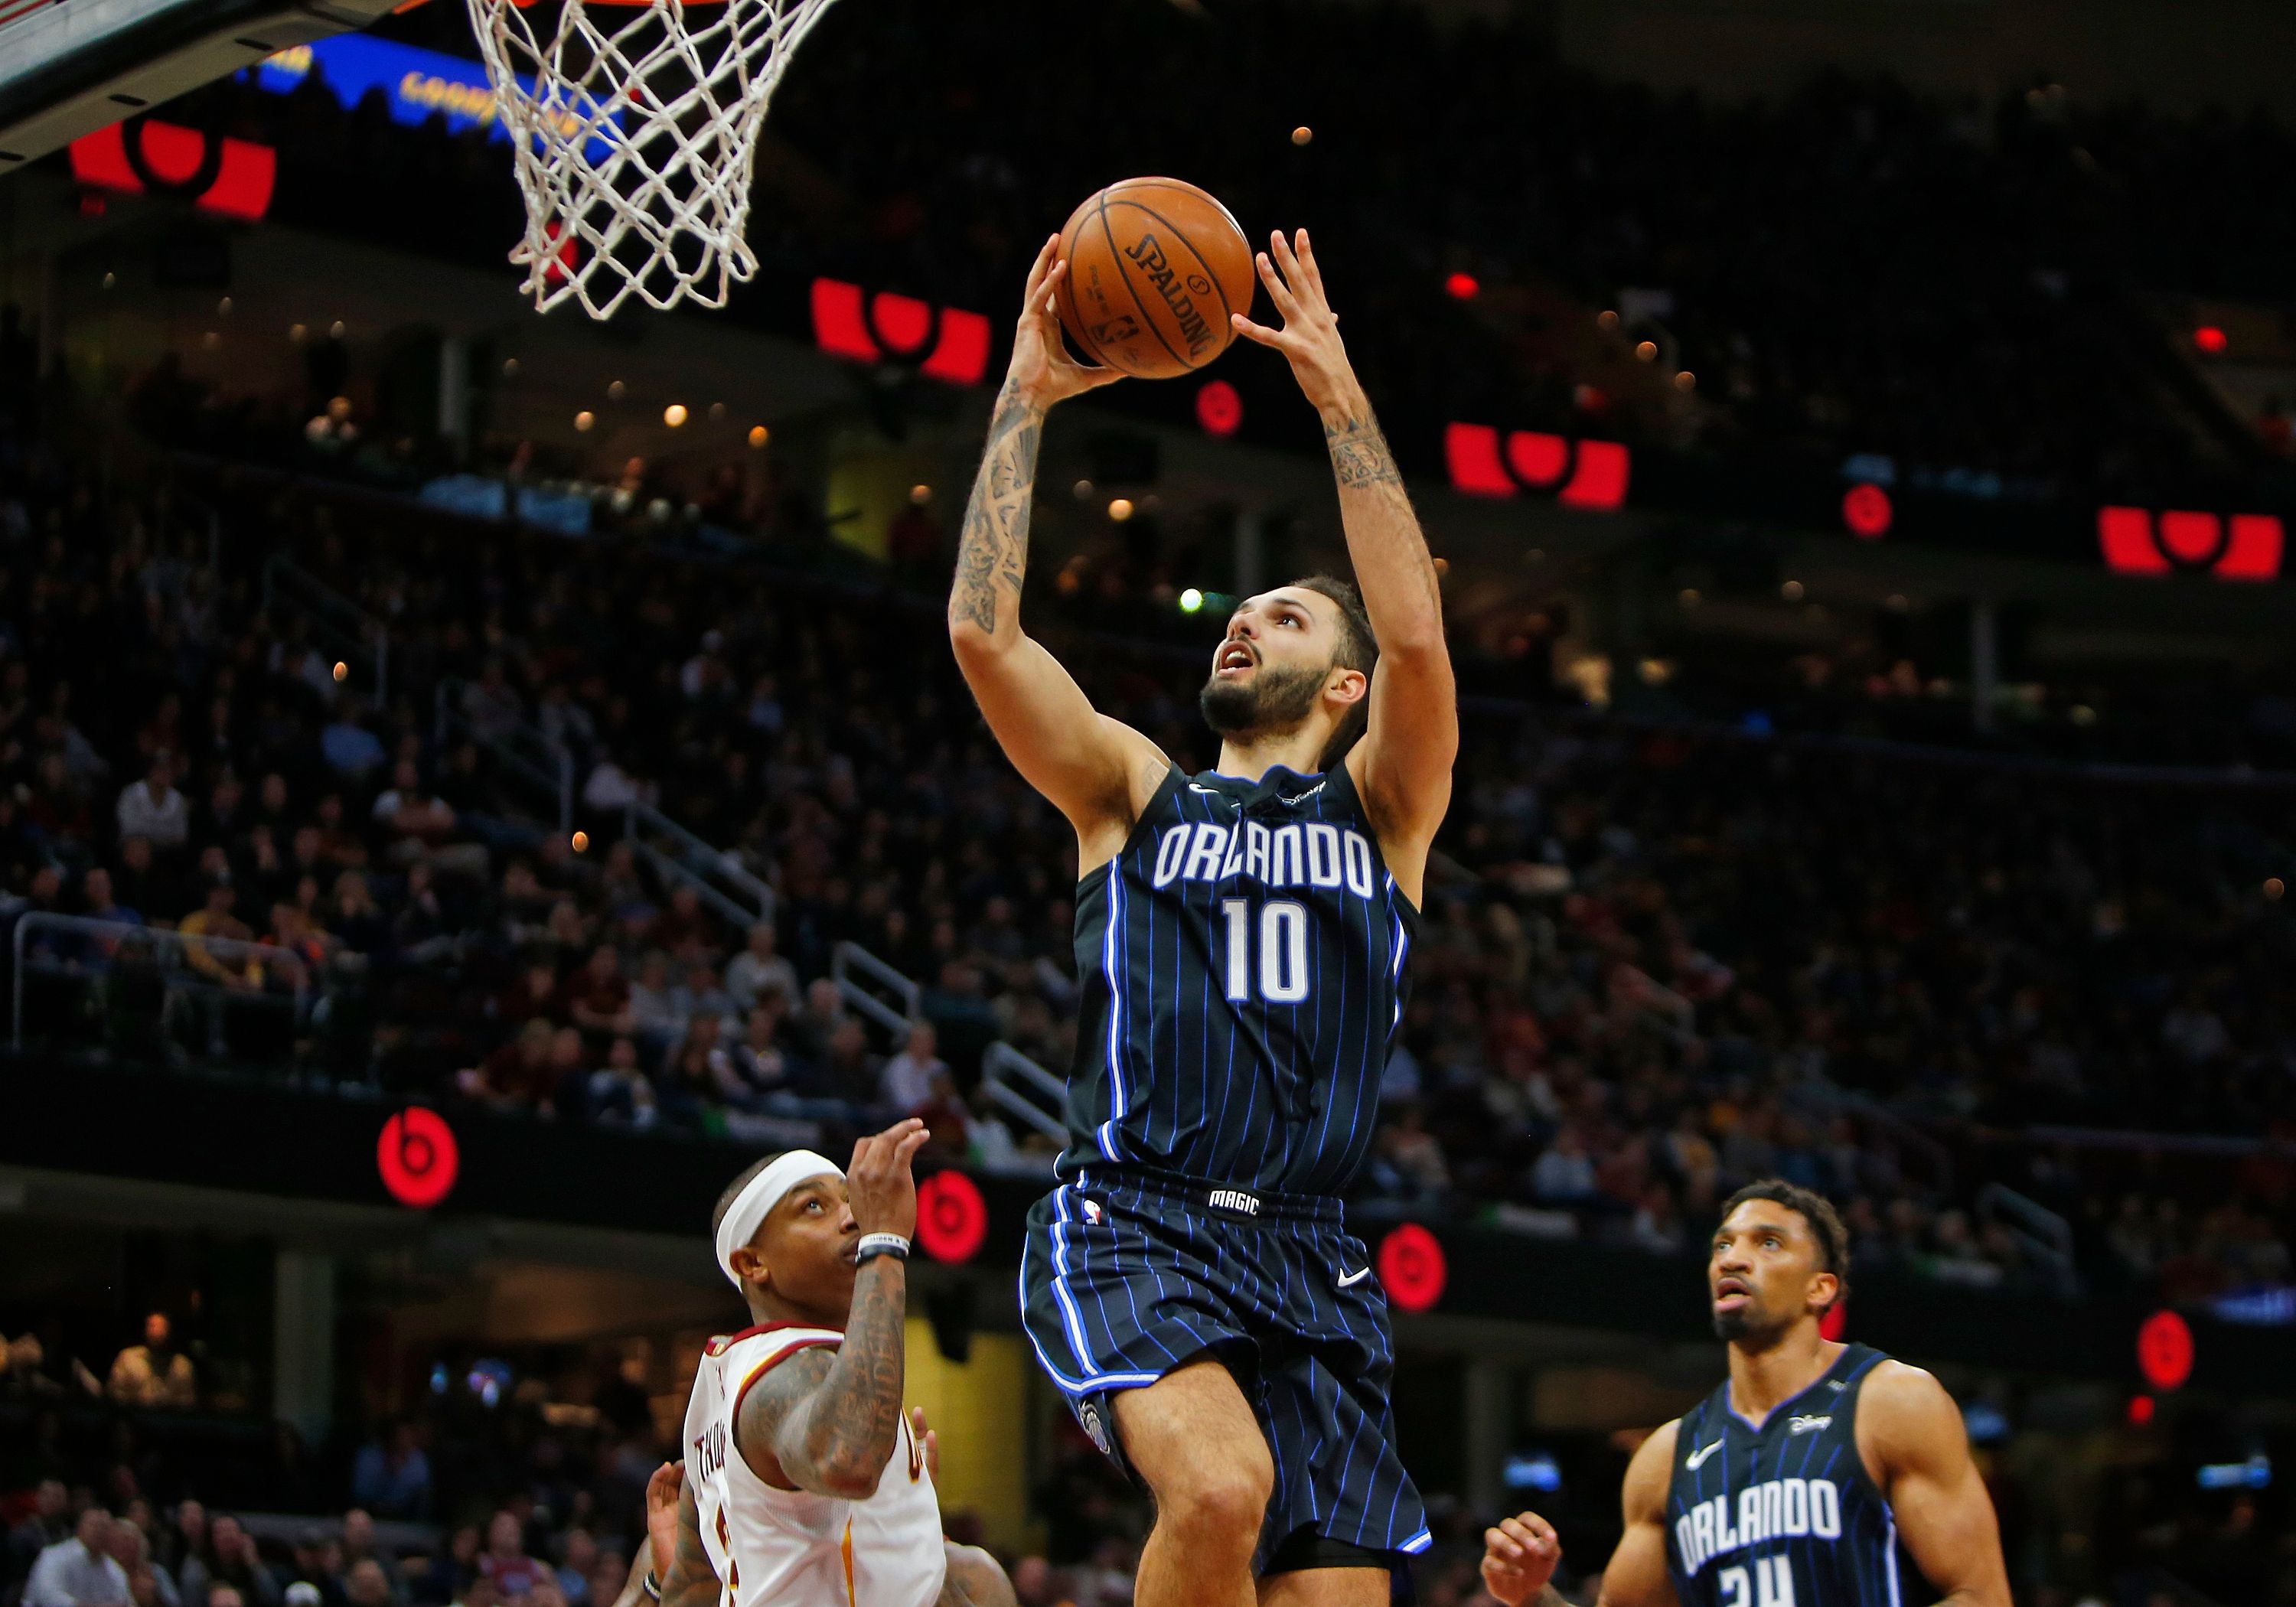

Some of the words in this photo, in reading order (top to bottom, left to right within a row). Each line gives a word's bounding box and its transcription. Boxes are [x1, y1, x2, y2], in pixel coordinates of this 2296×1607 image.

[1125, 233, 1218, 360] SPALDING
[1152, 818, 1375, 900] ORLANDO
[1221, 895, 1310, 1004] 10
[1208, 1188, 1261, 1217] MAGIC
[1789, 1413, 1833, 1436] Disney
[1675, 1478, 1842, 1577] ORLANDO
